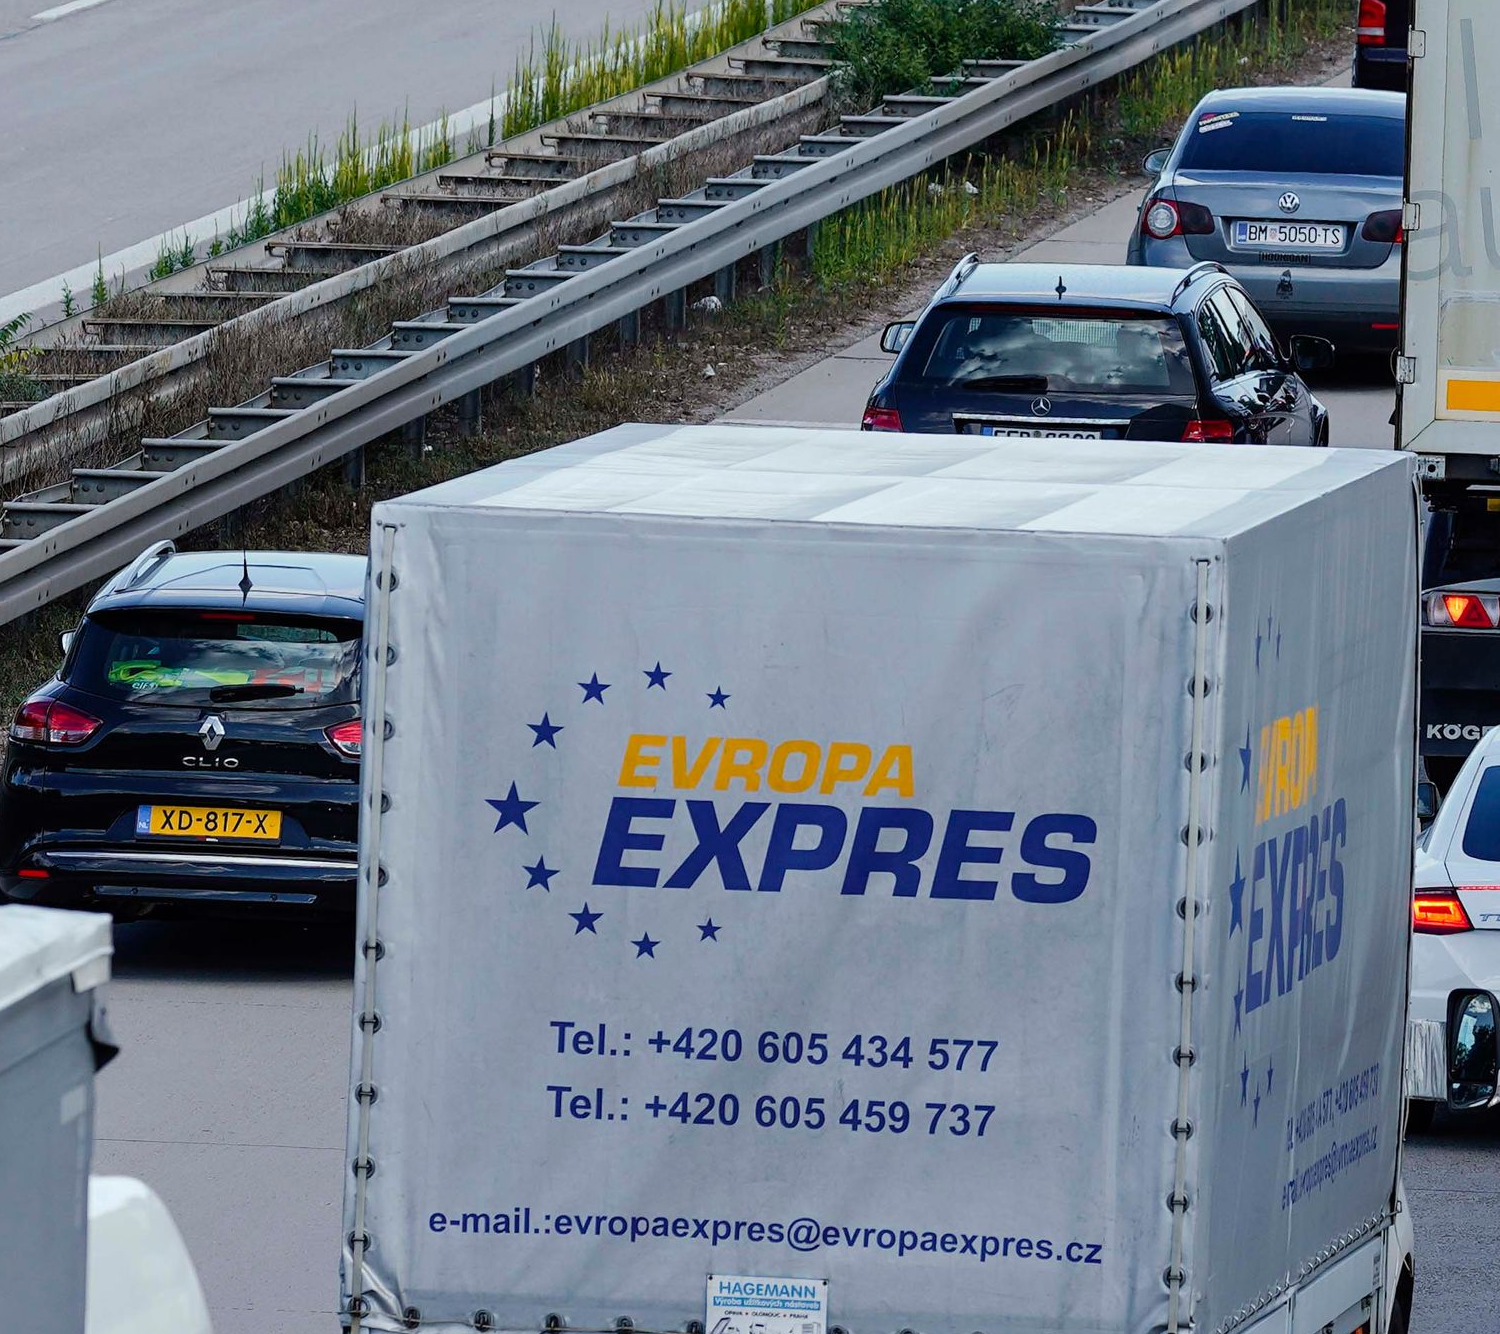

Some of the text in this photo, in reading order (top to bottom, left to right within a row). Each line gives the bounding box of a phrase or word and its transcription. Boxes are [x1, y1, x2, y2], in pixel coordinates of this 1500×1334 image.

[1248, 226, 1269, 241] BM
[182, 756, 240, 768] CLIO
[617, 733, 915, 798] EVROPA
[160, 809, 269, 834] XD-817-X
[592, 796, 1098, 905] EXPRES
[550, 1021, 999, 1073] Tel.: +420 605 434 577
[547, 1085, 997, 1138] Tel.: +420 605 459 737
[427, 1207, 1103, 1266] e-mail.:evropaexpres@evropaexpres.cz
[719, 1281, 817, 1299] HAGEMANN
